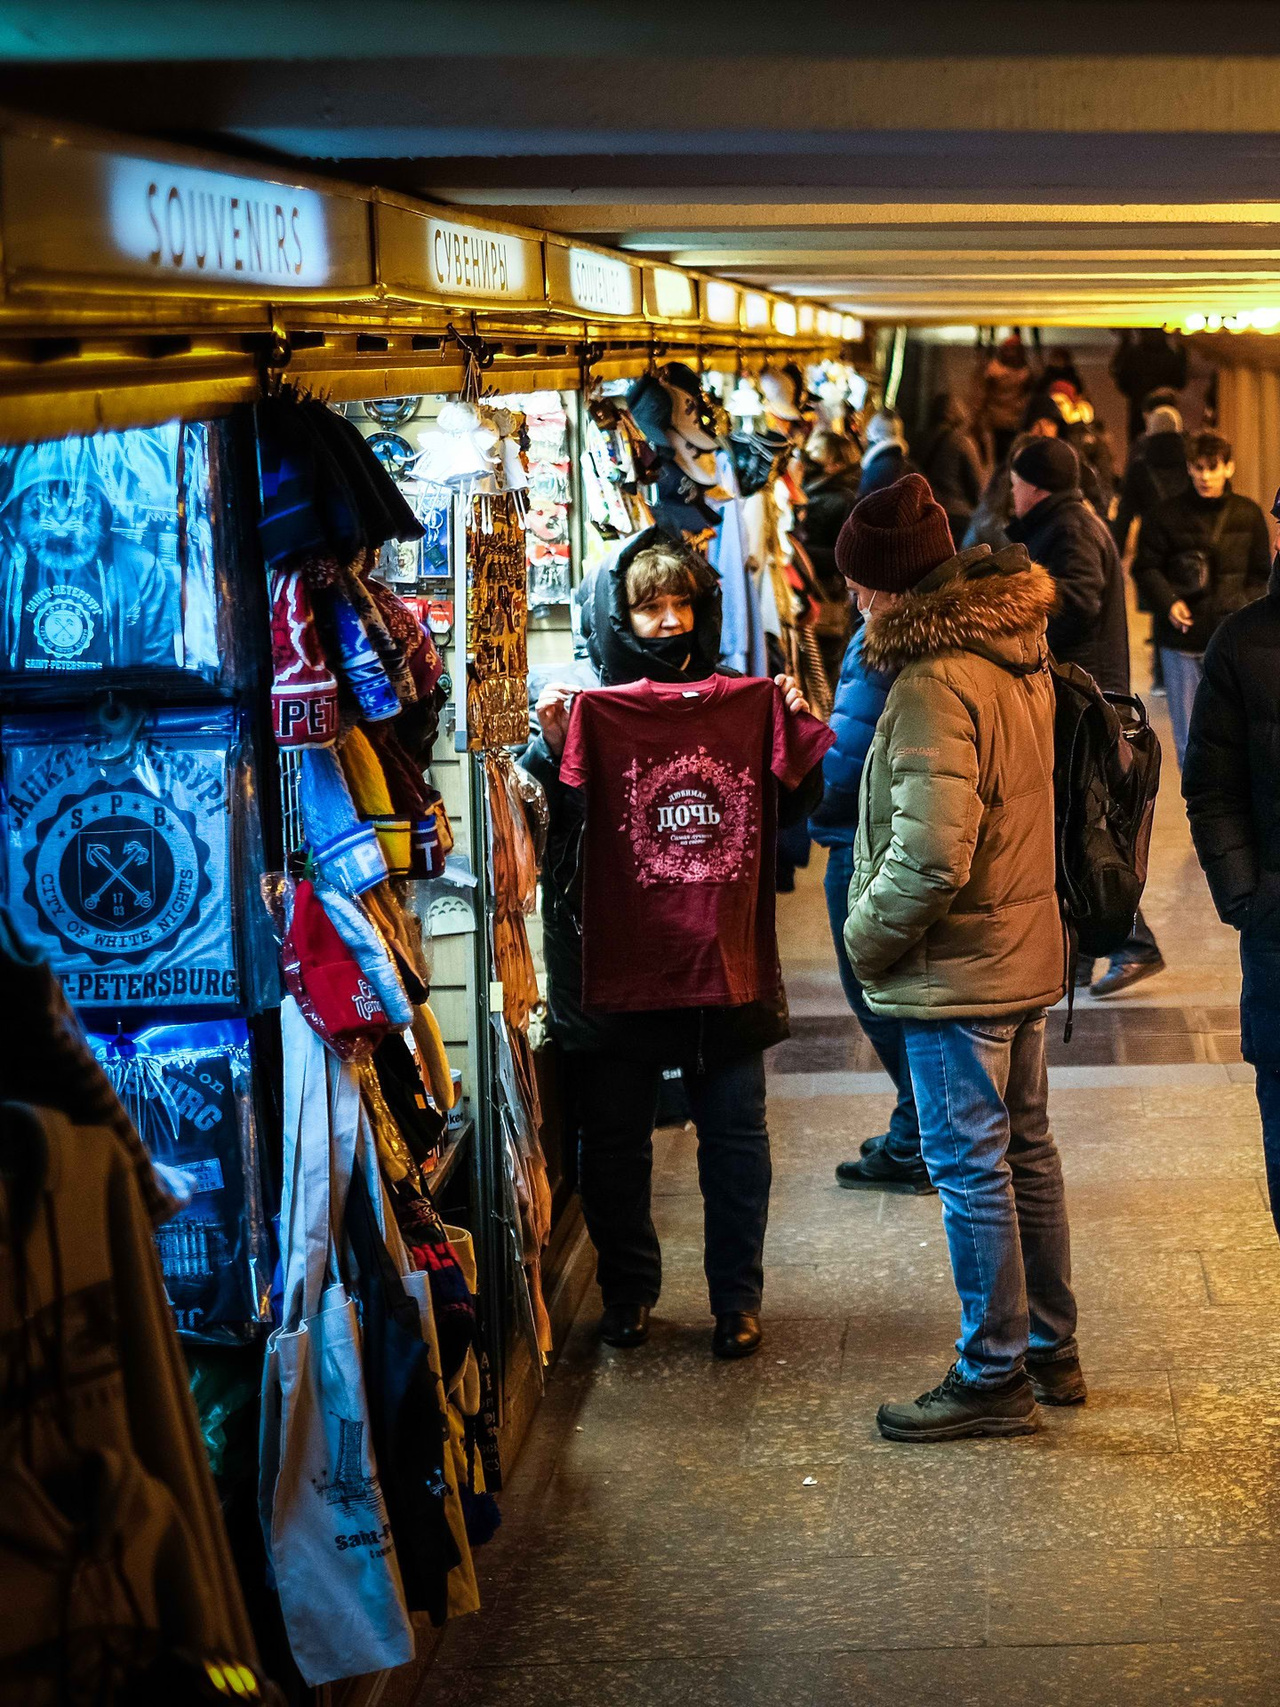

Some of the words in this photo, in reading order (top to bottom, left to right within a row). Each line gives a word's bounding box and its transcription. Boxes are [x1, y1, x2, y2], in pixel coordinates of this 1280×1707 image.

[146, 183, 303, 275] SOUVENIRS
[434, 228, 509, 292] СУВЕНИРЫ
[657, 804, 720, 832] ДОЧЬ
[41, 873, 66, 917] CITY
[66, 920, 90, 939] OF
[94, 930, 152, 948] WHITE
[156, 869, 193, 933] NIGHTS
[112, 892, 124, 904] 17
